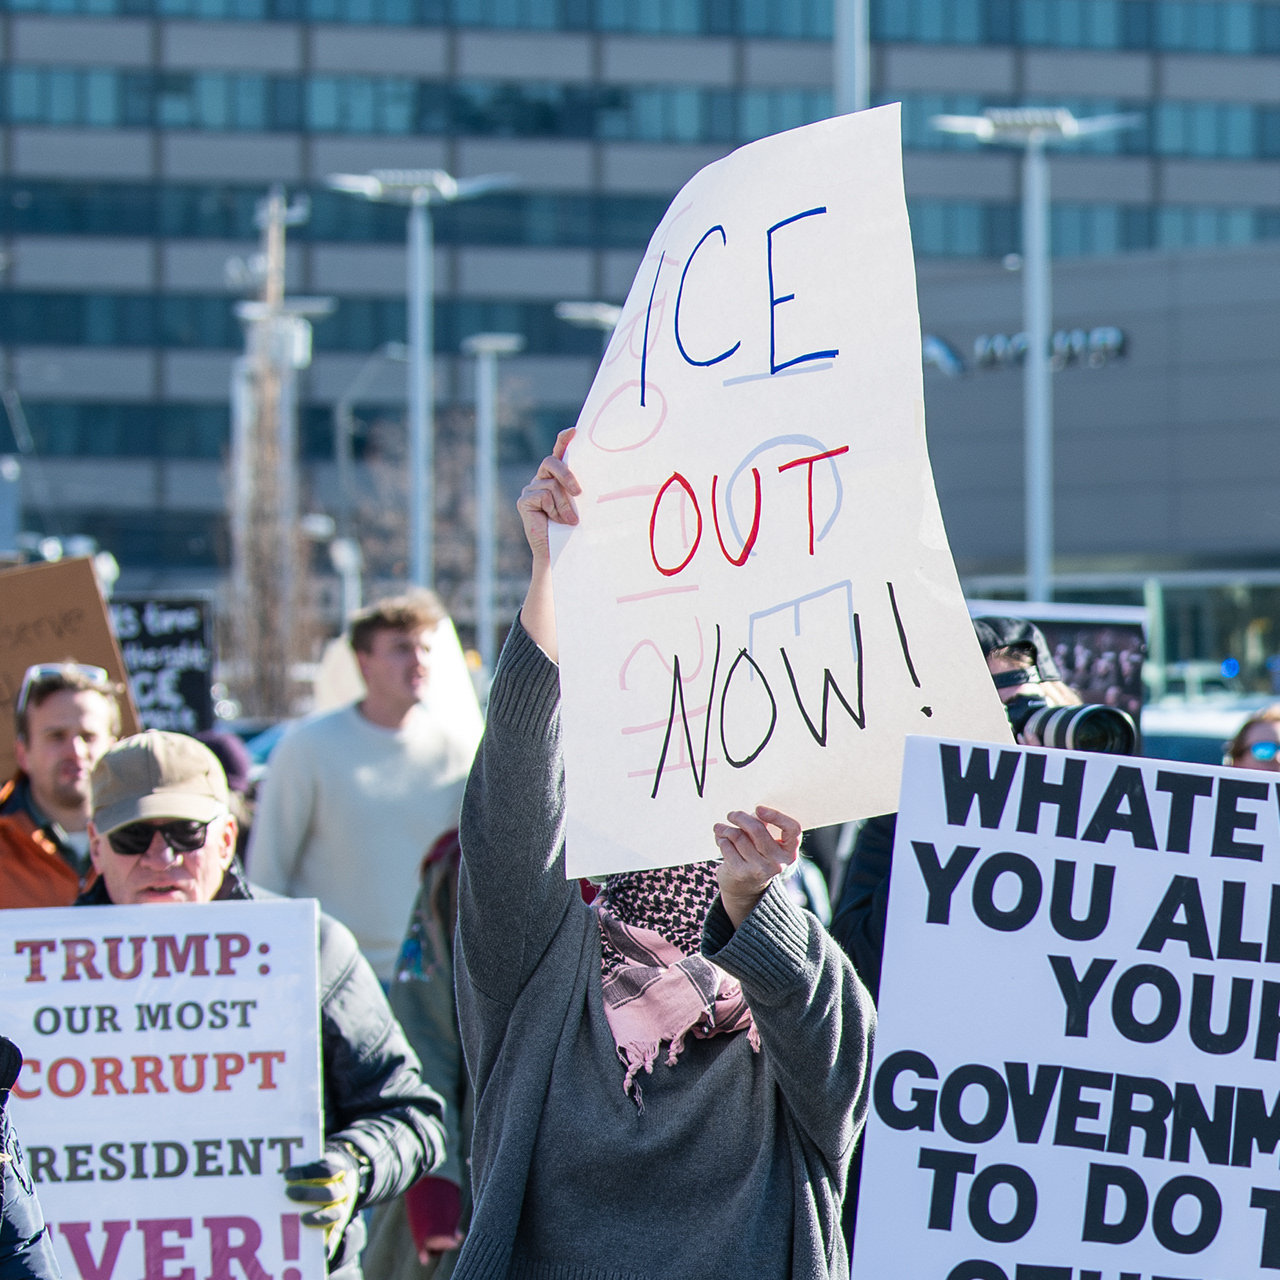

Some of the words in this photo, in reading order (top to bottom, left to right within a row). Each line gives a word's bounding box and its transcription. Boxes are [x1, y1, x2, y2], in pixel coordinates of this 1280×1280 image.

[640, 206, 839, 407] ICE
[648, 444, 850, 577] OUT
[651, 580, 933, 800] NOW!
[910, 841, 1117, 941] YOU
[14, 933, 271, 983] TRUMP:
[33, 1005, 121, 1035] OUR
[136, 1000, 257, 1031] MOST
[11, 1050, 286, 1100] CORRUPT
[26, 1136, 304, 1183] RESIDENT
[918, 1148, 1038, 1244] TO
[1081, 1162, 1222, 1255] DO
